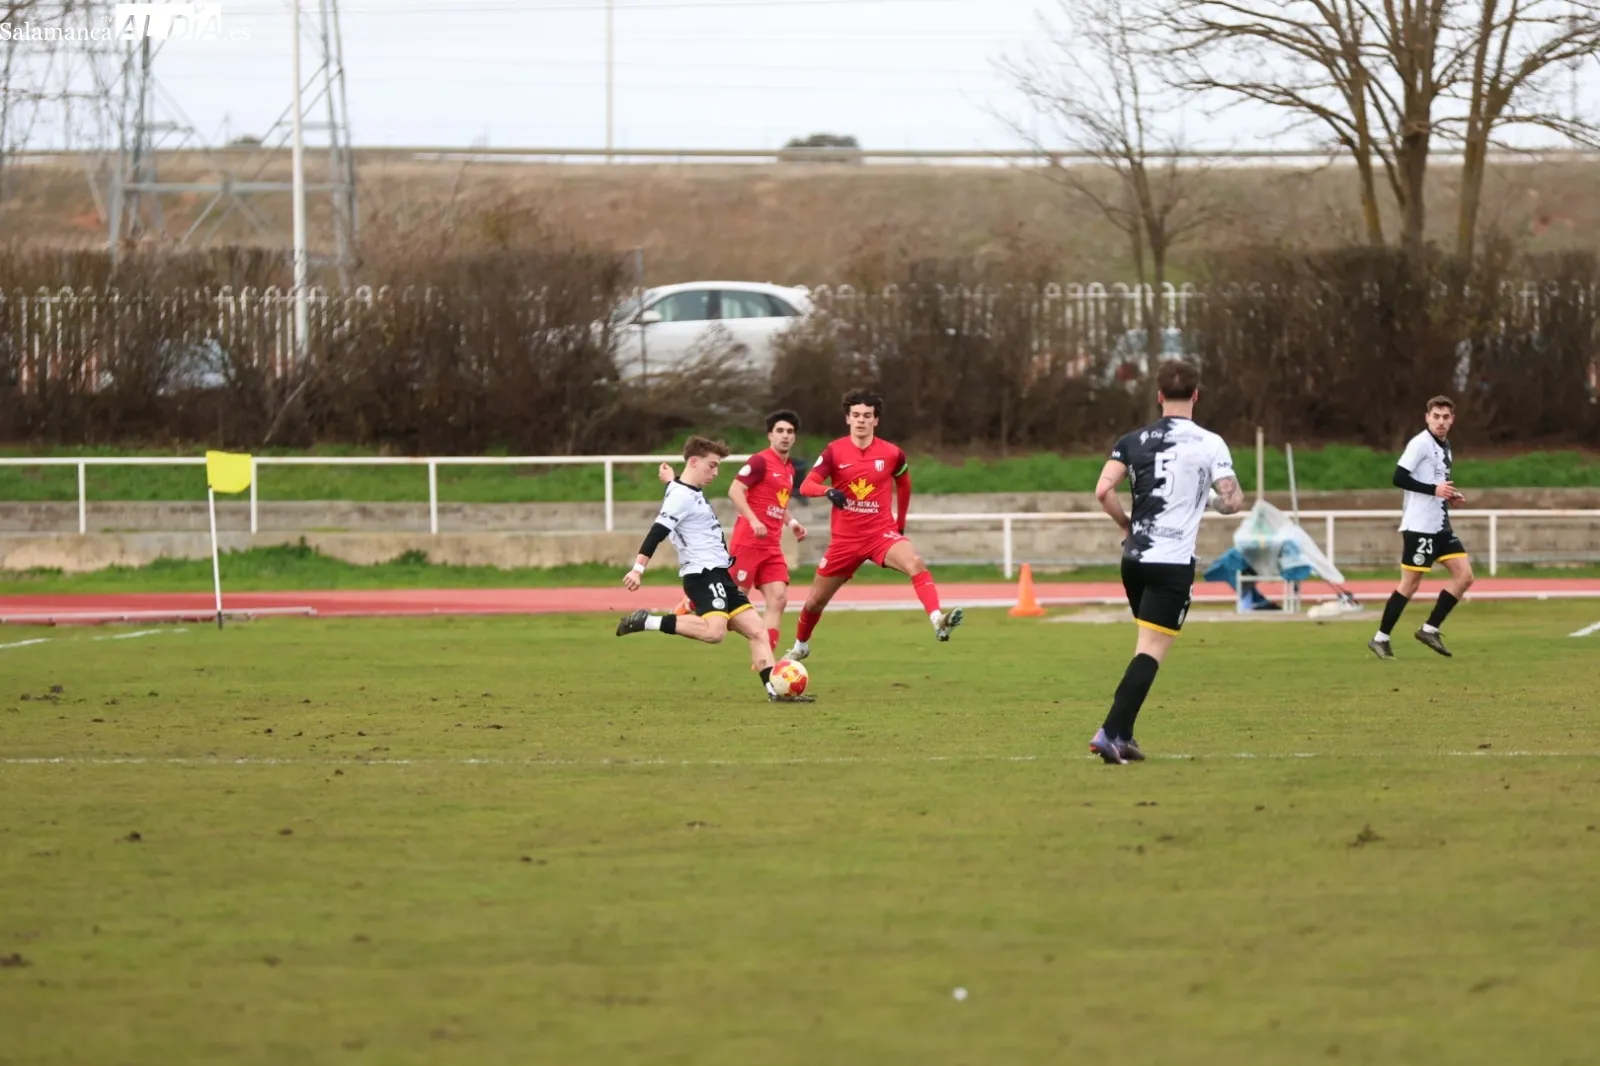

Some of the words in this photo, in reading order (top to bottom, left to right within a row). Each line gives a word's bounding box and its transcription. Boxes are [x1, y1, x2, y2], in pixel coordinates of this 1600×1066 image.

[1151, 451, 1177, 497] 5
[1416, 537, 1433, 554] 23
[708, 582, 727, 598] 18
